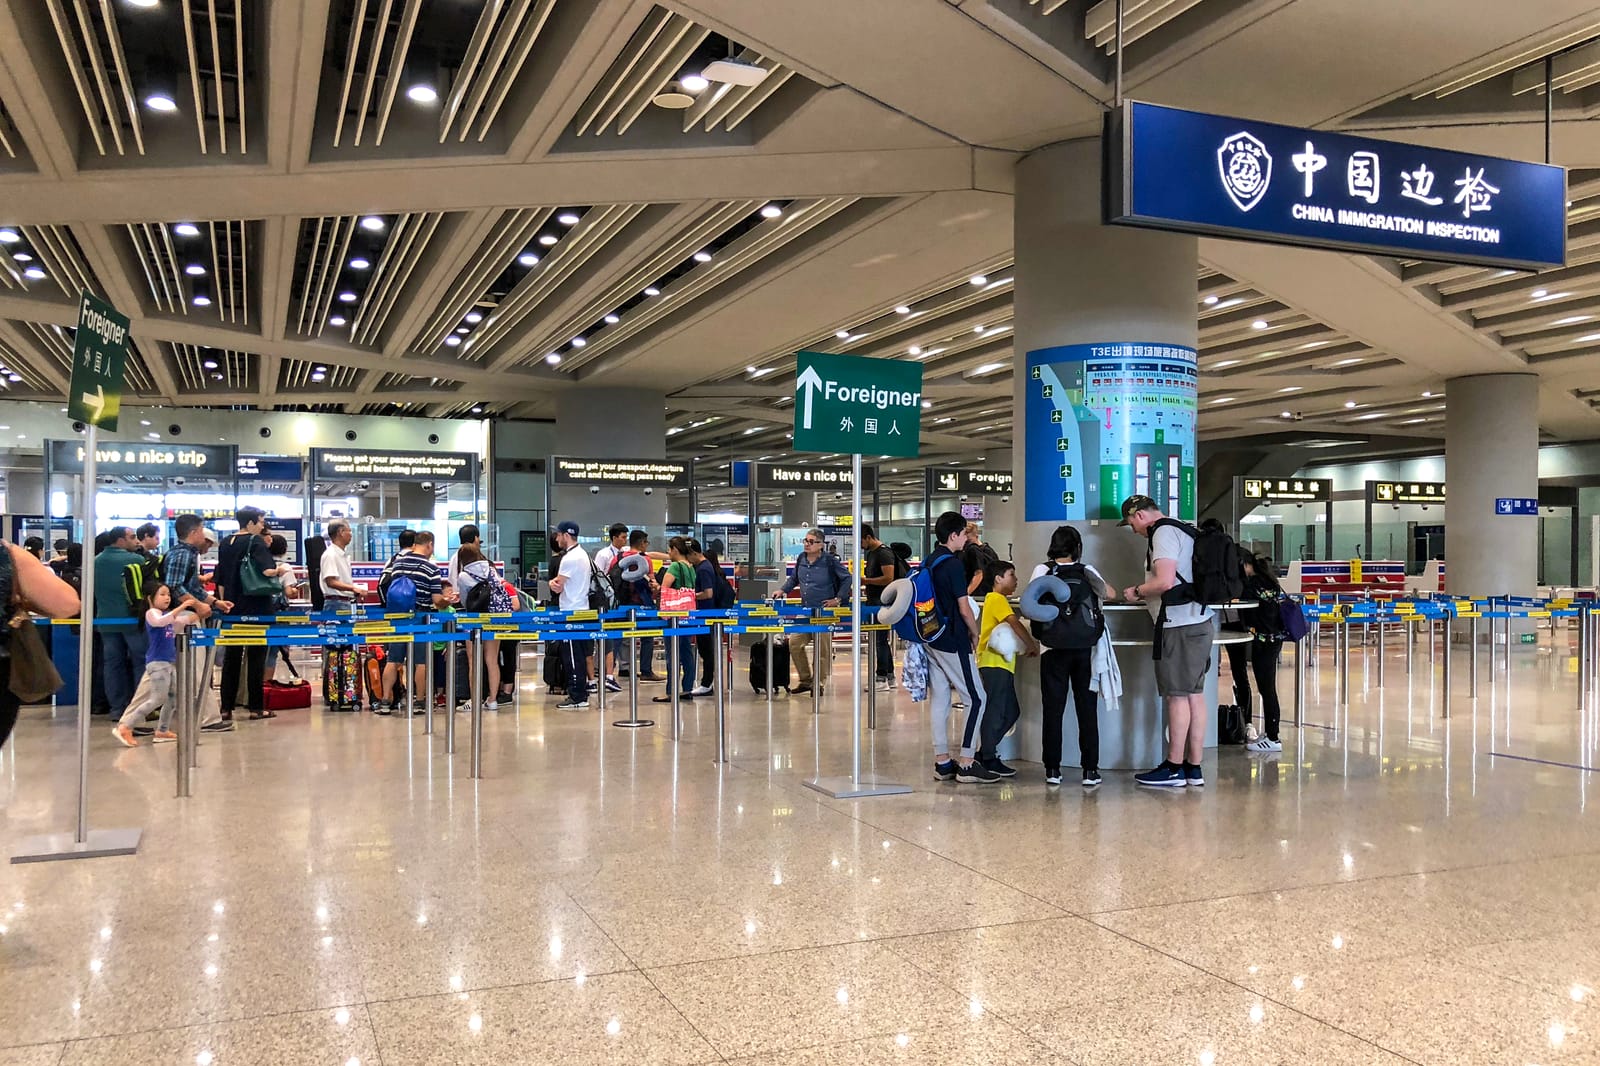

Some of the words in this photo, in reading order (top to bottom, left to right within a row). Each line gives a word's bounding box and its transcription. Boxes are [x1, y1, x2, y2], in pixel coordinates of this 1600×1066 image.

[1291, 140, 1500, 218] 中国边检
[1292, 203, 1335, 223] CHINA
[1338, 209, 1424, 234] IMMIGRATION
[1426, 221, 1500, 244] INSPECTION
[81, 298, 126, 346] Foreigner
[83, 346, 112, 378] 外国人
[824, 380, 921, 409] Foreigner
[840, 416, 901, 436] 外国人
[125, 451, 136, 463] a
[139, 449, 175, 464] nice
[178, 450, 207, 468] trip
[323, 453, 353, 463] Please
[353, 455, 369, 465] get
[369, 456, 389, 465] your
[559, 461, 585, 469] Please
[586, 463, 599, 471] get
[599, 463, 616, 471] your
[334, 464, 355, 473] card
[355, 465, 373, 473] and
[373, 465, 411, 476] boarding
[411, 467, 432, 476] pass
[432, 466, 457, 477] ready
[569, 471, 587, 479] card
[603, 471, 636, 481] boarding
[636, 473, 654, 481] pass
[654, 473, 676, 482] ready
[773, 468, 802, 481] Have
[804, 471, 811, 481] a
[813, 469, 837, 482] nice
[969, 472, 1012, 484] Foreign
